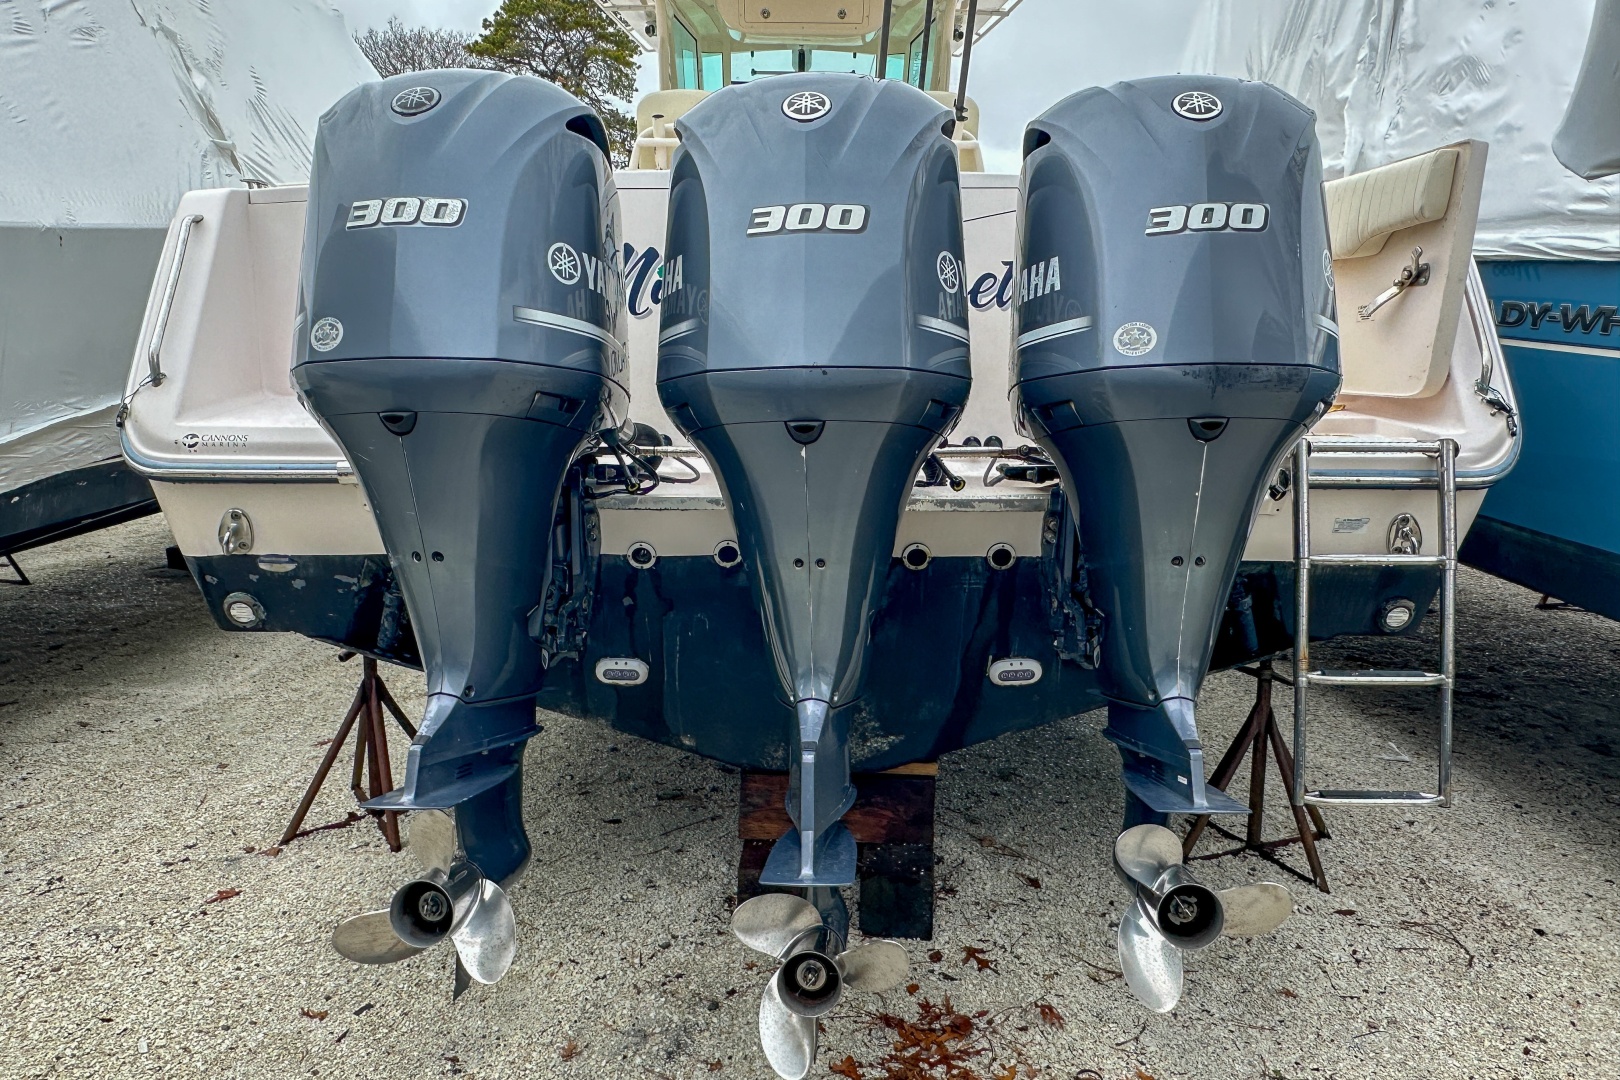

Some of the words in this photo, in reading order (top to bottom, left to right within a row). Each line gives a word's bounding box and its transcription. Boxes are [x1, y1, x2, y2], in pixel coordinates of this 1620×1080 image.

[346, 197, 466, 229] 300
[746, 203, 867, 235] 300
[1145, 203, 1268, 235] 300
[201, 434, 249, 442] CANNONS
